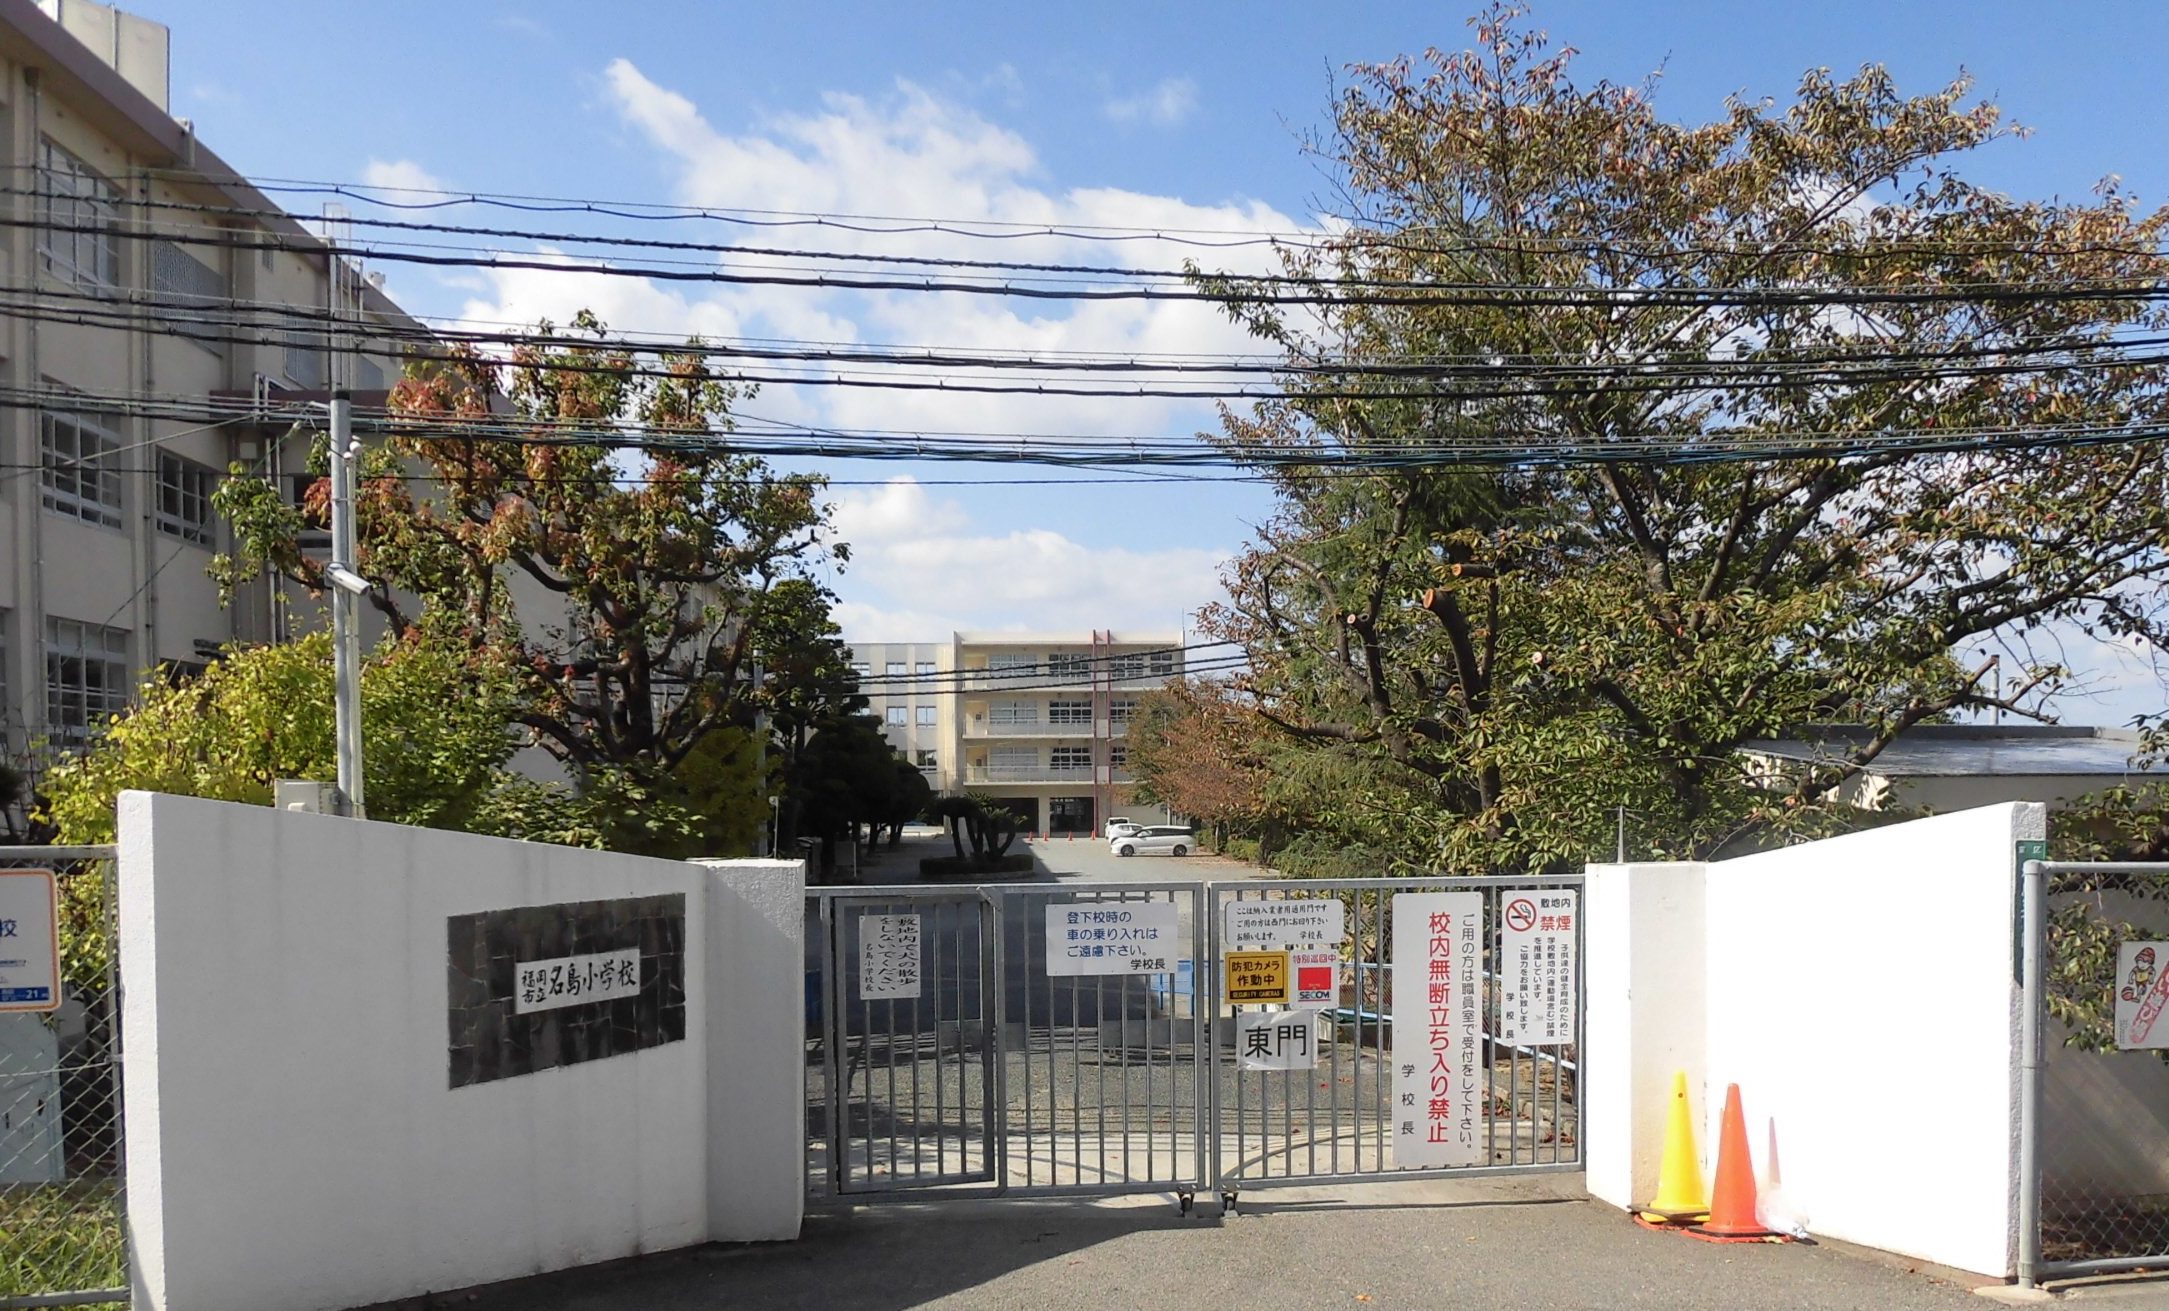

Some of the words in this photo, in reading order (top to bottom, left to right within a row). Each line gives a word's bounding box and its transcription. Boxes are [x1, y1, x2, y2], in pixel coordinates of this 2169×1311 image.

[1541, 898, 1571, 908] 敷地内
[1067, 911, 1132, 924] 登下校時の
[1237, 917, 1328, 928] ご用の方は西門にお回り下さい
[1540, 915, 1571, 931] 禁煙
[1067, 928, 1159, 940] 車の乗り入れは
[1237, 932, 1276, 941] お願いします。
[1299, 931, 1323, 940] 学校長
[878, 917, 896, 991] をしないでください
[897, 917, 919, 986] 敷地内で犬の散歩
[1067, 945, 1147, 957] ご遠慮下さい。
[1293, 953, 1336, 964] 特別巡回中
[865, 943, 875, 992] 名島小学校長
[1130, 958, 1165, 970] 学校長
[1232, 961, 1280, 972] 防犯カメラ
[1533, 937, 1542, 1002] を推進しています。
[549, 959, 636, 995] 名島小学校
[1237, 974, 1274, 986] 作動中
[1299, 991, 1330, 999] SECOM
[1519, 945, 1528, 1034] ご協力をお願い致します。
[1560, 944, 1569, 1036] 子供達の健全育成のために
[1505, 992, 1515, 1039] 学校長
[1427, 912, 1451, 1142] 校内無断立ち入り禁止
[1460, 913, 1477, 1148] ご用の方は職員室で受付をして下さい。
[1245, 1025, 1307, 1058] 東門
[1401, 1064, 1415, 1135] 学校長
